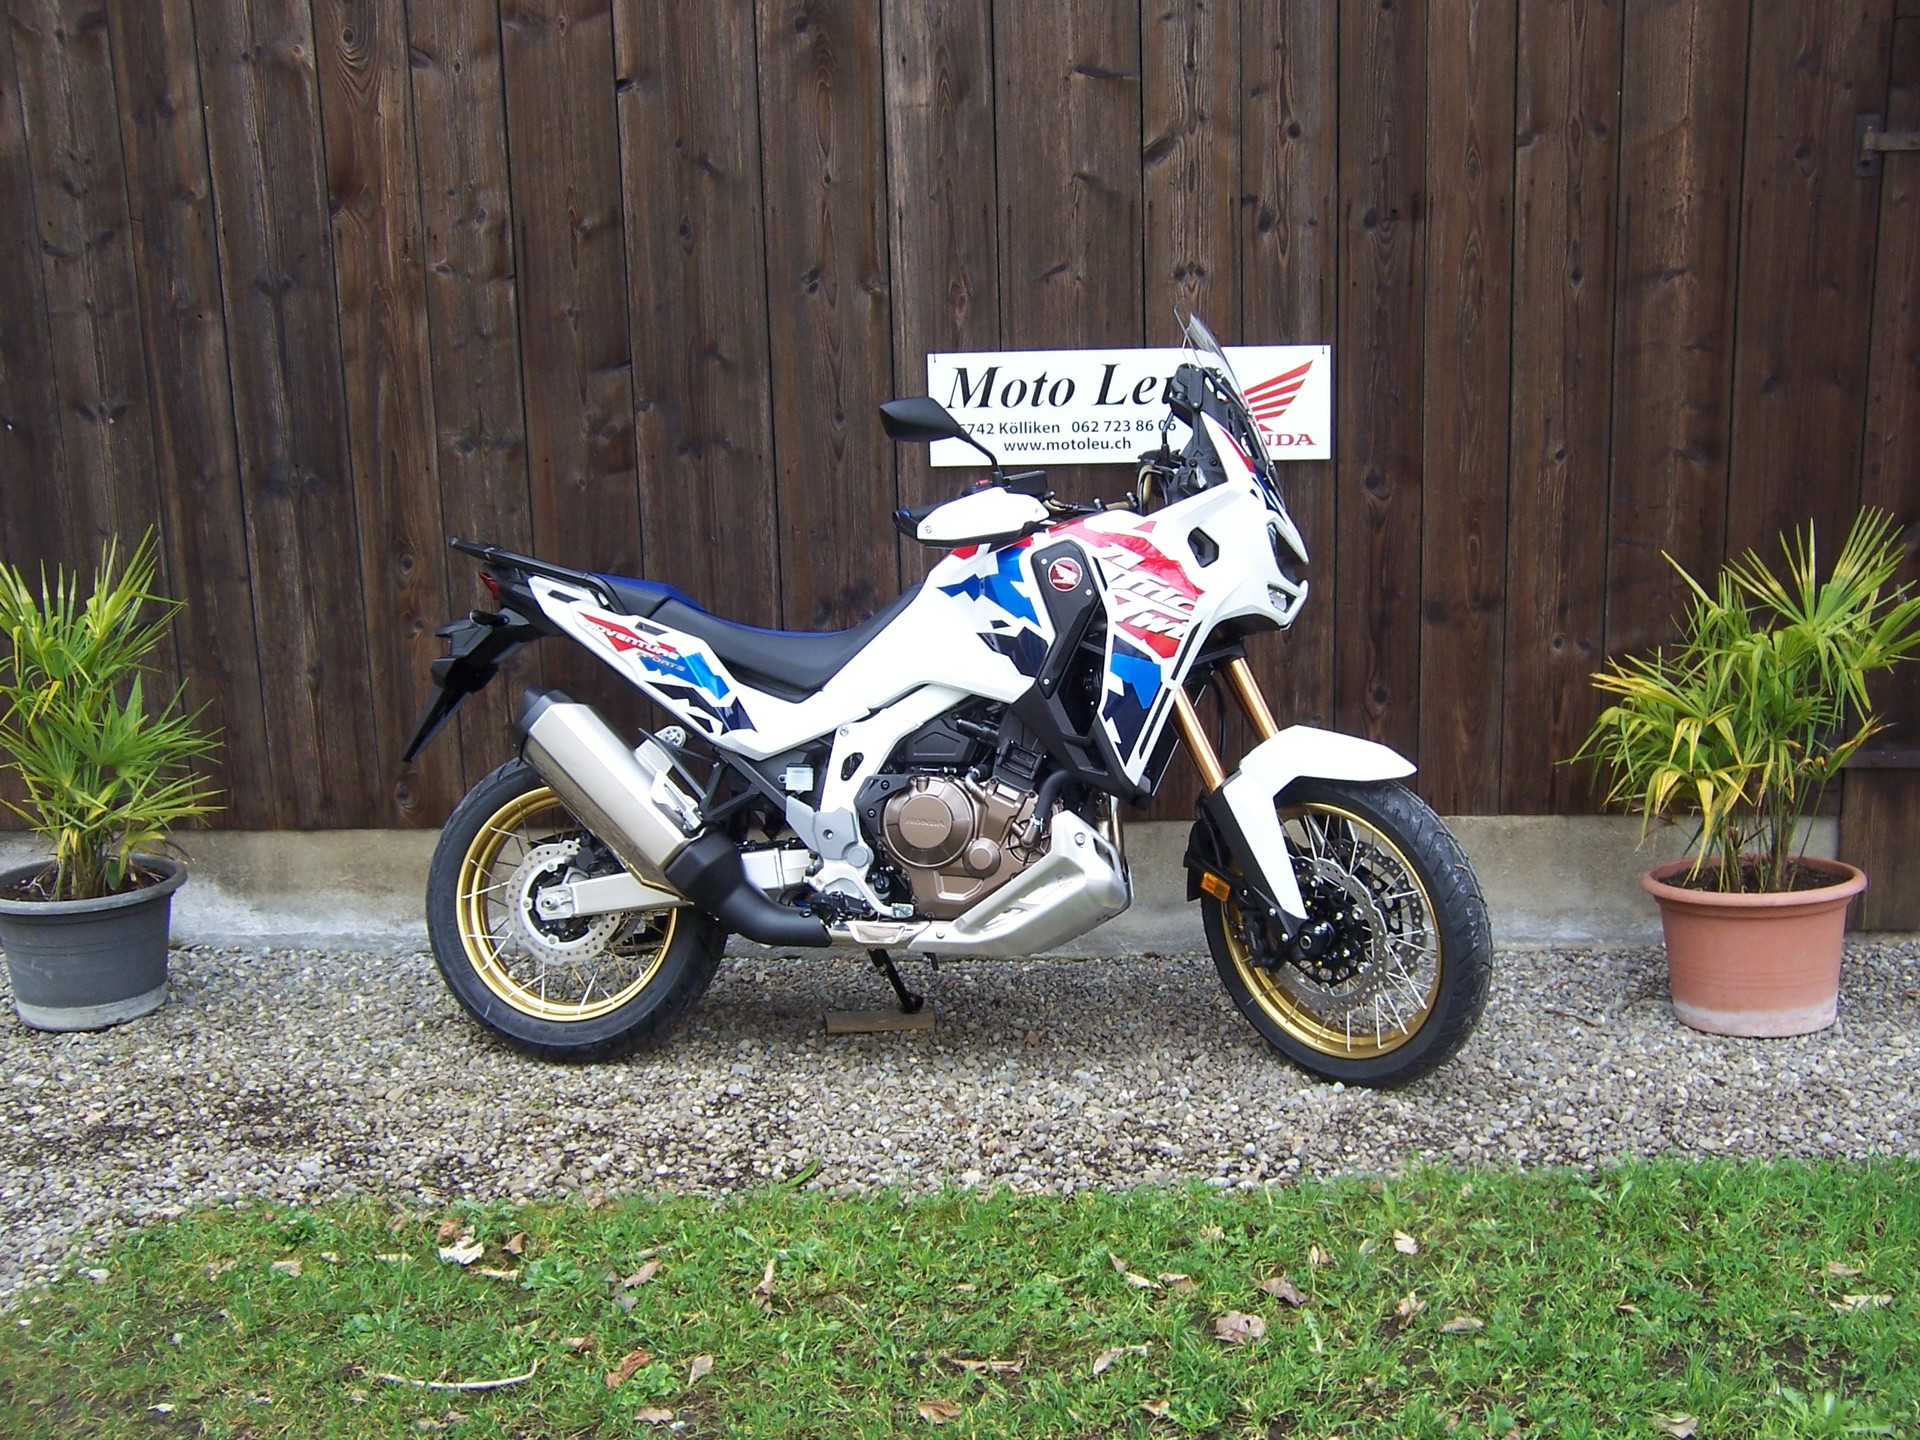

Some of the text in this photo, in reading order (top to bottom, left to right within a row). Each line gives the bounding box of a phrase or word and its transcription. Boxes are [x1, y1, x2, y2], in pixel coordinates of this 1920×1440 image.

[945, 366, 1075, 408] Moto
[959, 422, 995, 435] 742
[999, 420, 1060, 434] Kölliken
[1071, 420, 1099, 433] 062
[1104, 420, 1131, 432] 723
[1136, 419, 1154, 431] 86
[1003, 436, 1131, 452] www.motoleu.ch
[905, 816, 945, 828] HONDA
